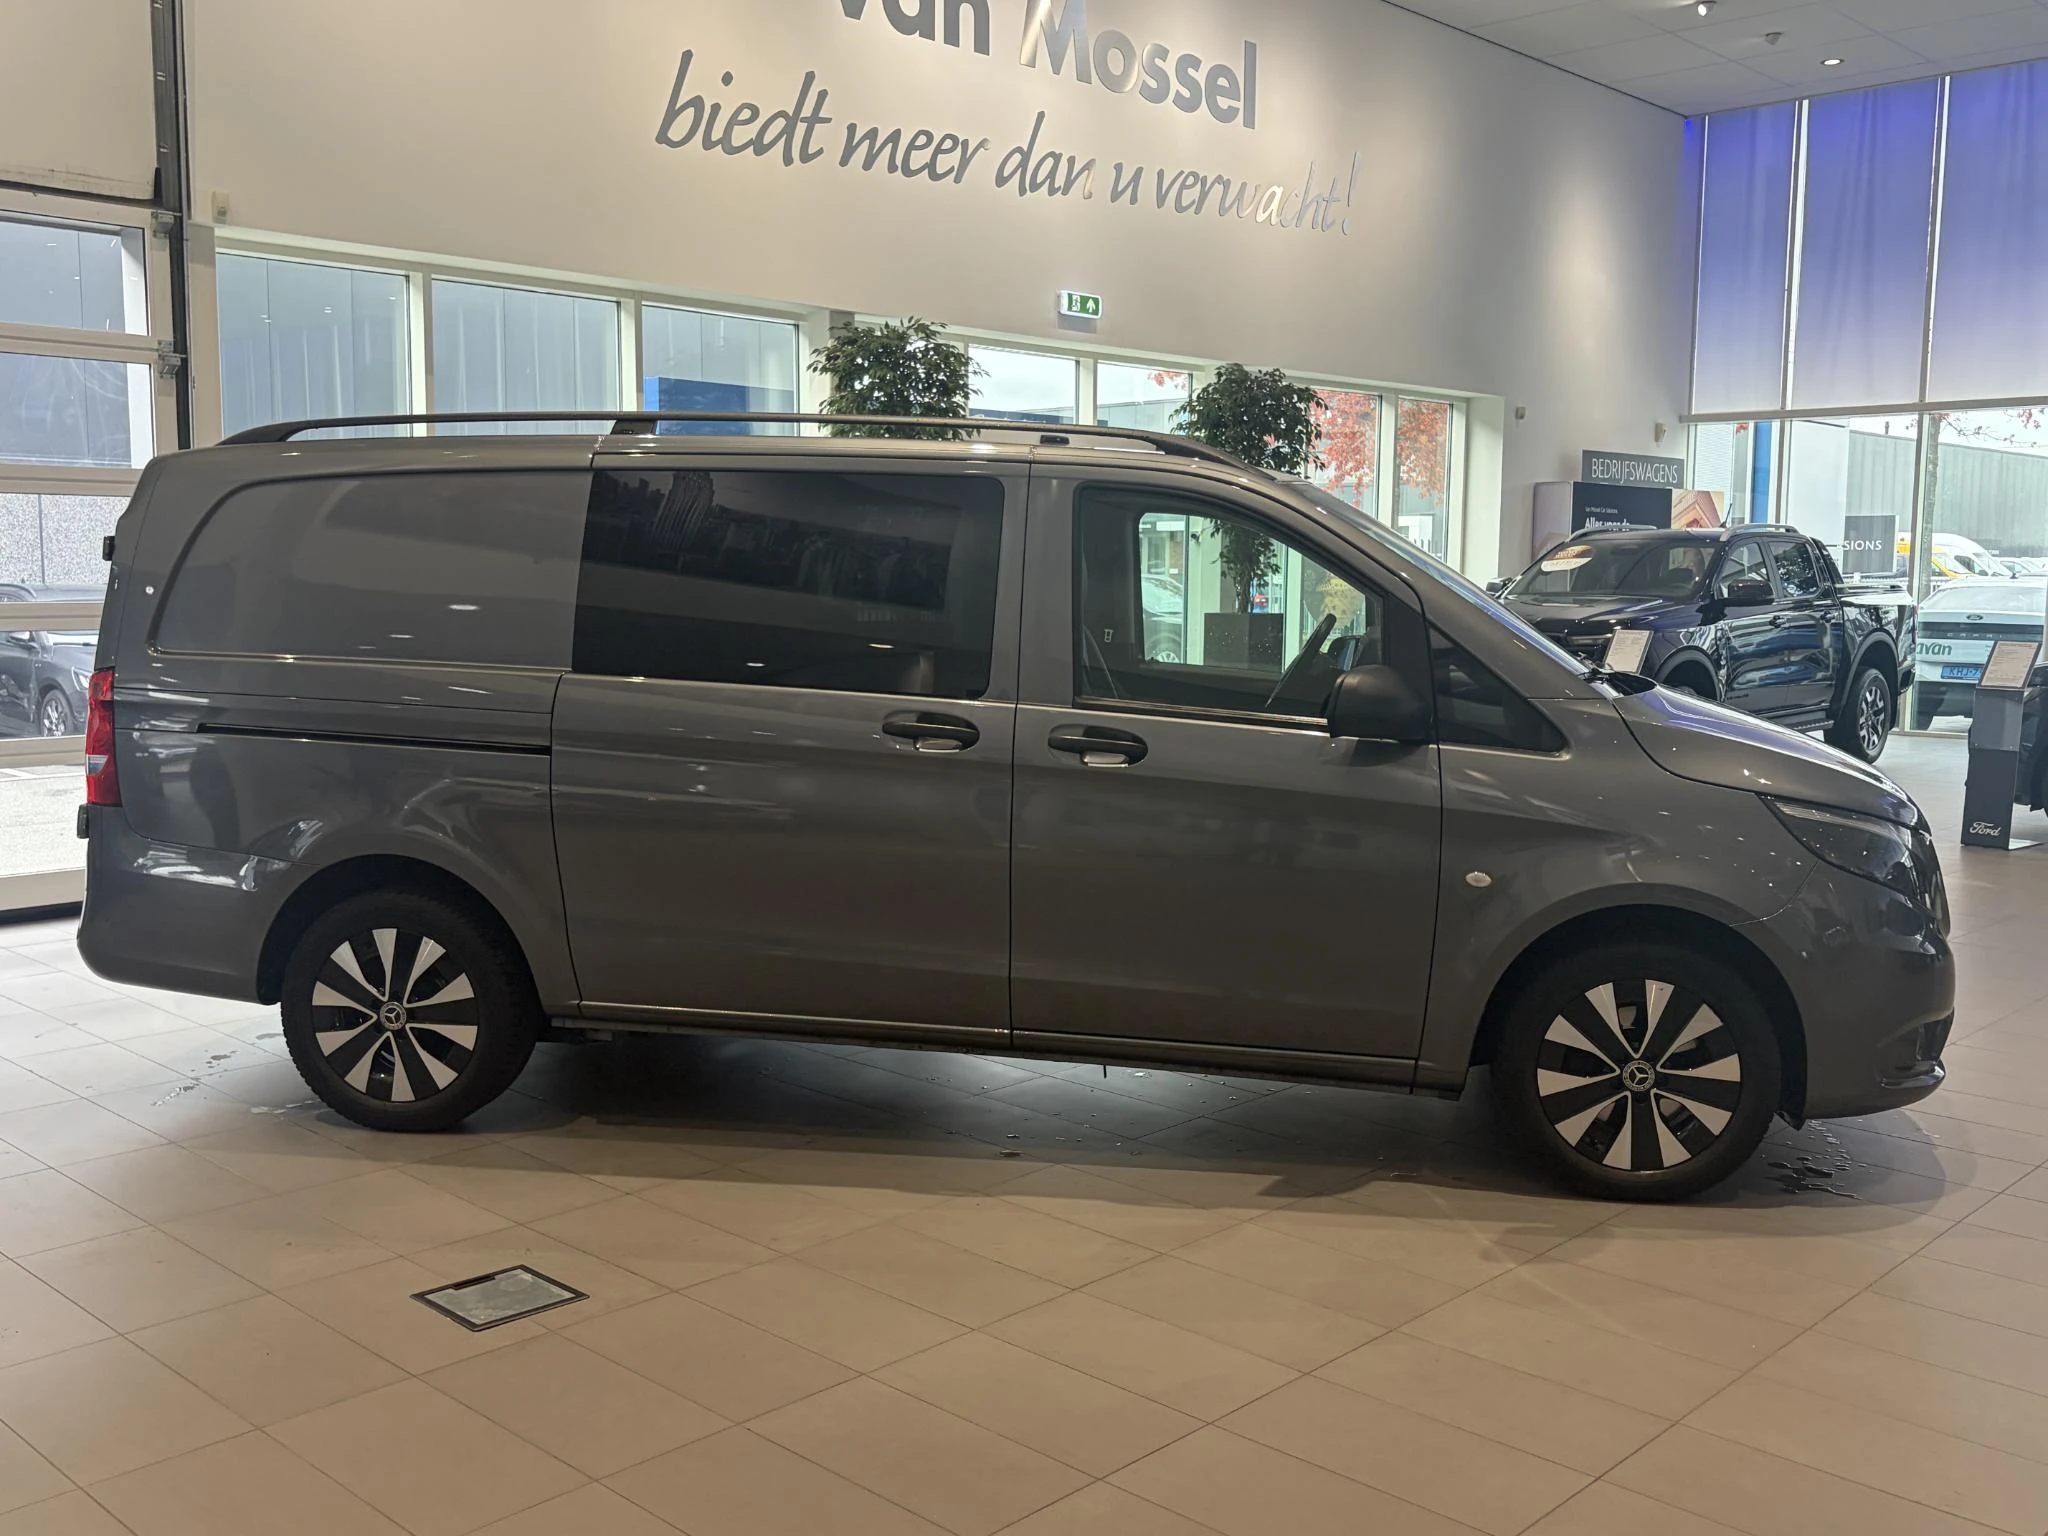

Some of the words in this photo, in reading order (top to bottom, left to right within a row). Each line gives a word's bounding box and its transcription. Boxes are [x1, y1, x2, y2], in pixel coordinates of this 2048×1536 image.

[840, 0, 990, 57] an
[1019, 0, 1257, 130] Mossel
[655, 49, 832, 168] biedt
[838, 122, 991, 184] meer
[995, 110, 1097, 200] dan
[1110, 162, 1144, 206] u
[1156, 151, 1361, 236] verwacht!
[1591, 458, 1678, 484] BEDRIJFSWAGENS
[1949, 666, 1983, 677] KHJ-7
[1969, 821, 2001, 836] Ford
